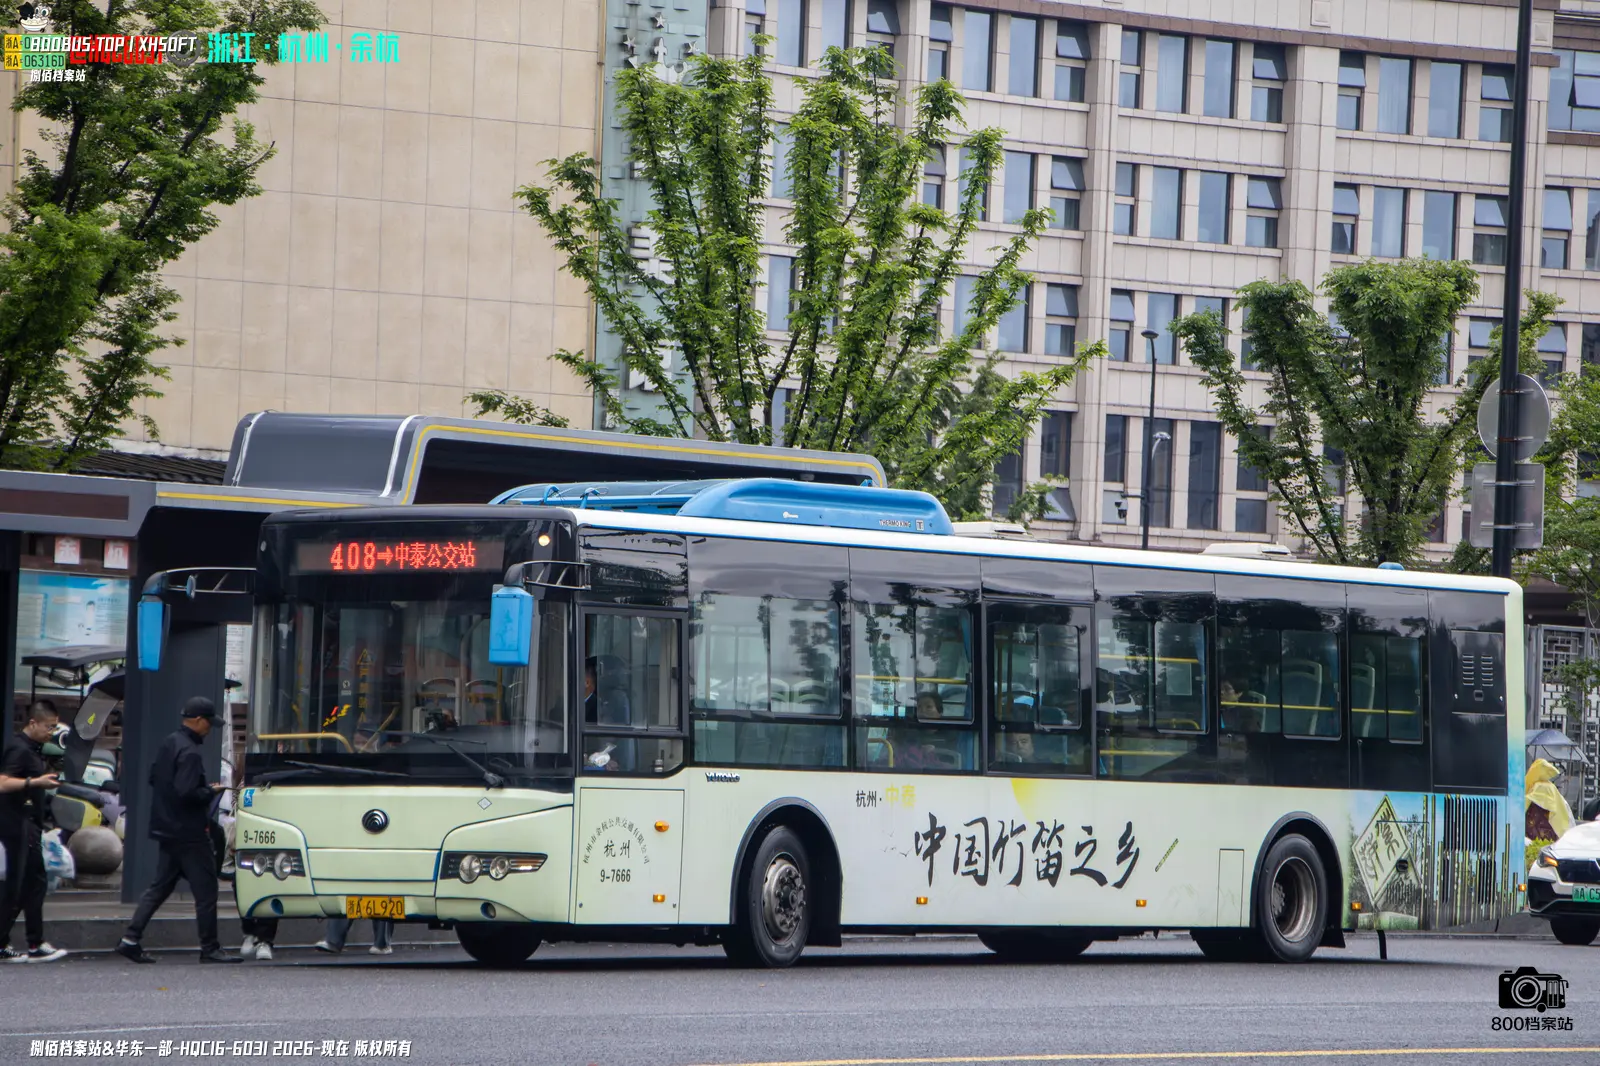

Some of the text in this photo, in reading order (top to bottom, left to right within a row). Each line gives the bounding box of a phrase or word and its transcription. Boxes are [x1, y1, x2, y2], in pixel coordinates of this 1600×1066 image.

[330, 542, 376, 570] 408
[395, 541, 476, 569] 中泰公交站
[243, 830, 276, 845] 9-7666
[604, 839, 631, 858] 杭州
[914, 812, 1140, 889] 中国竹笛之乡
[600, 869, 631, 883] 9-7666
